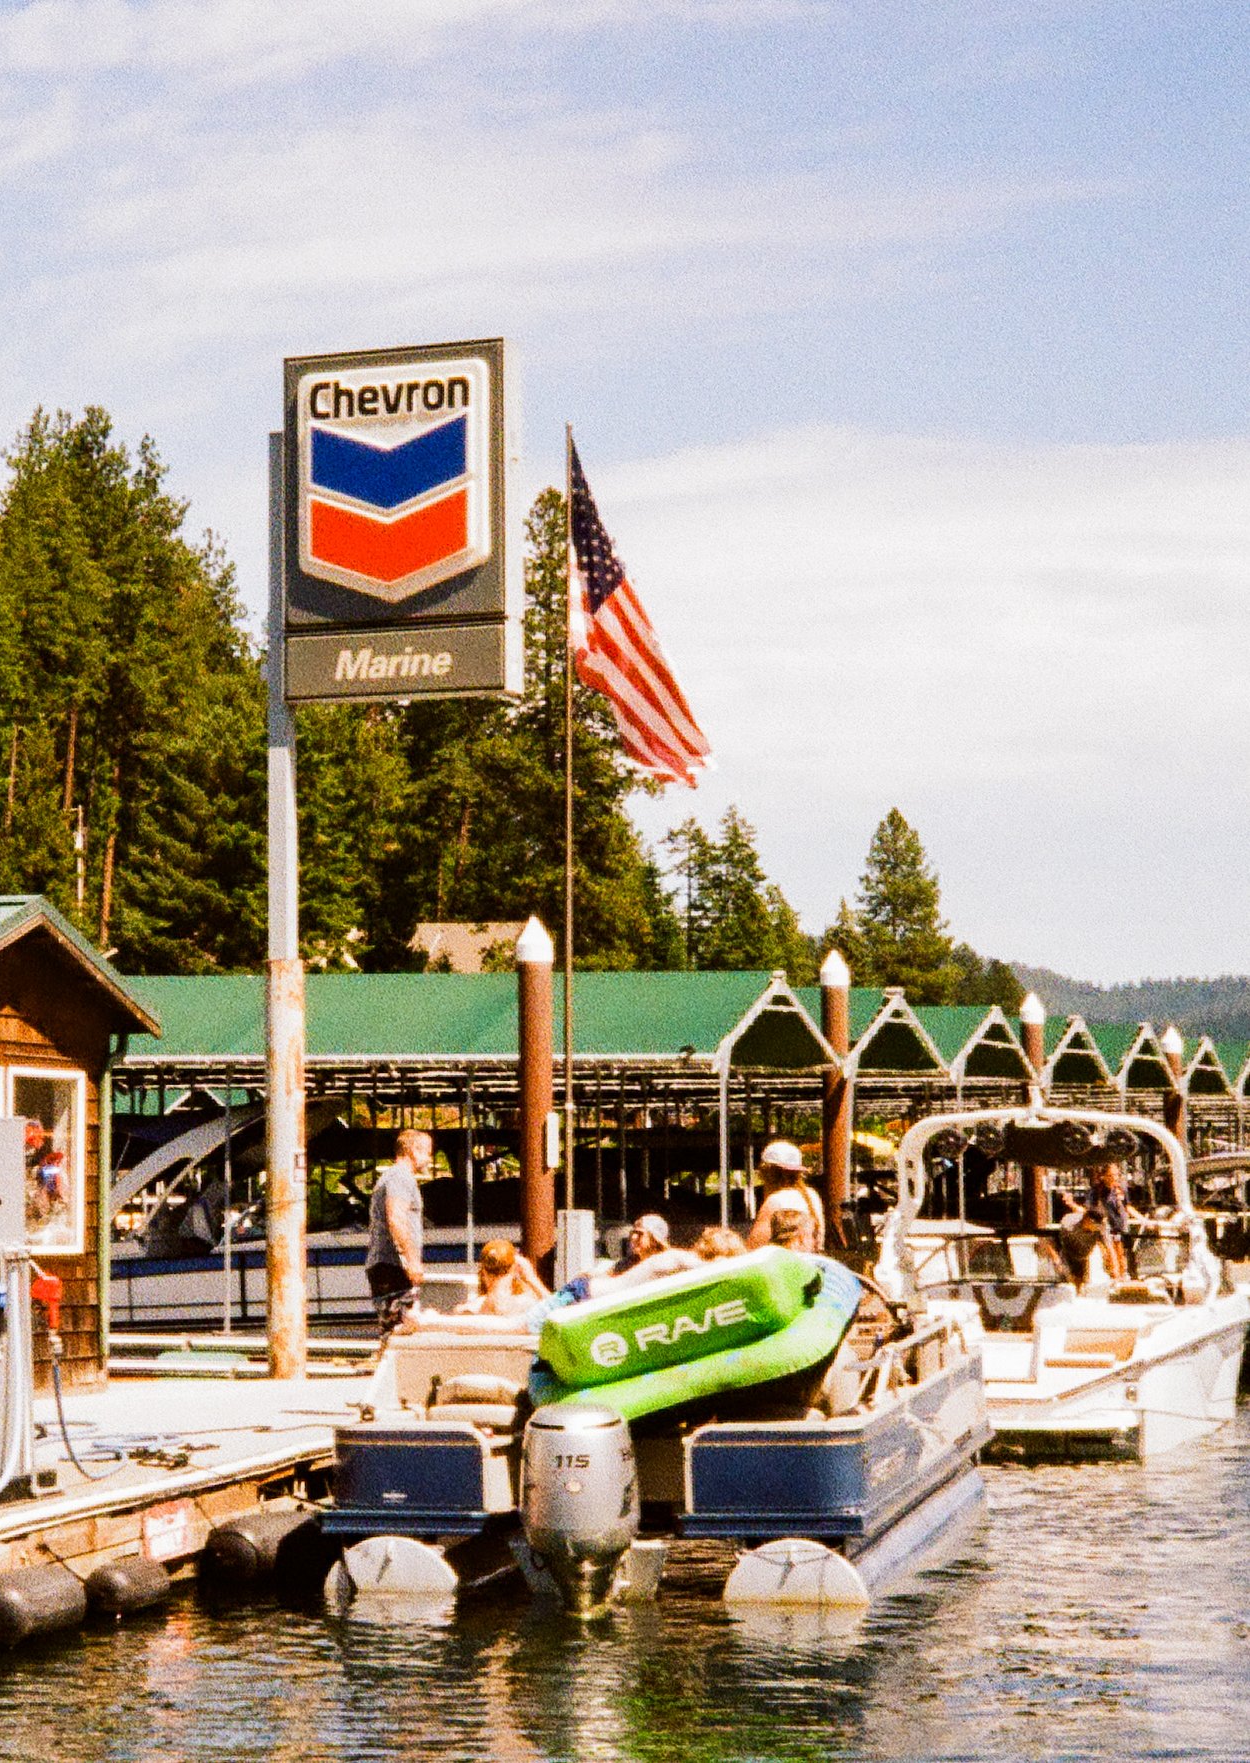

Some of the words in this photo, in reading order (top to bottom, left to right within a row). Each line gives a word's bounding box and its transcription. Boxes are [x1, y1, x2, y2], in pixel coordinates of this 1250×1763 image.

[310, 376, 469, 419] Chevron
[334, 646, 453, 681] Marine
[634, 1299, 748, 1351] RAVE
[554, 1453, 590, 1469] 115
